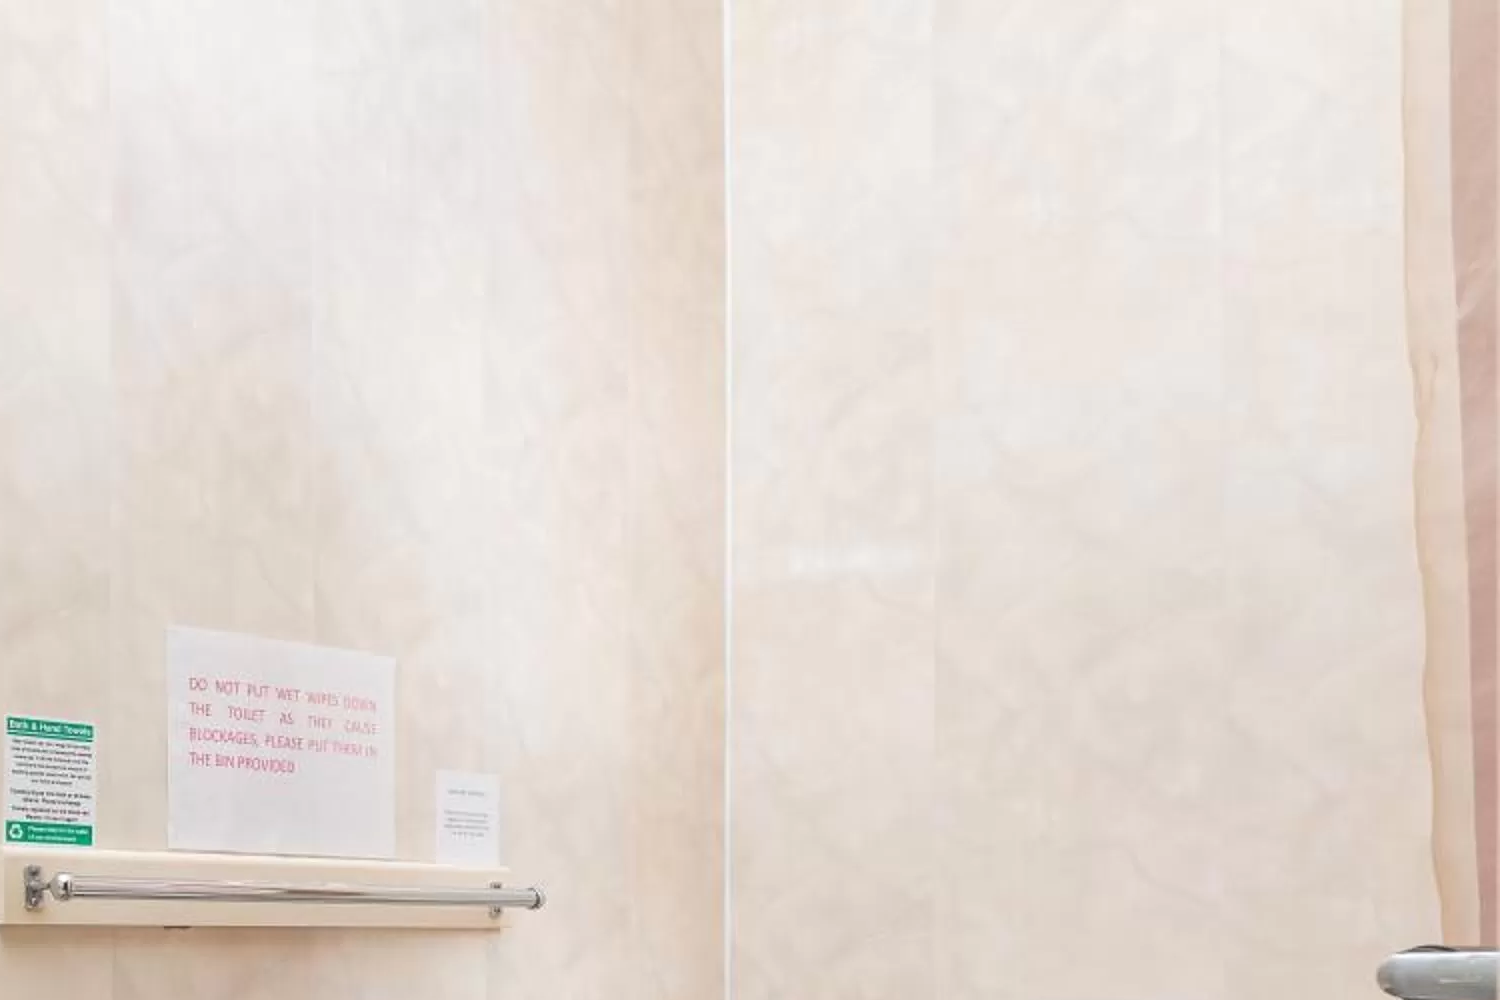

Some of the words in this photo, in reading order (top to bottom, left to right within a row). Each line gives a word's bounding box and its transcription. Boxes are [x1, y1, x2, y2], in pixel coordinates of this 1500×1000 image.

[188, 677, 209, 691] DO
[215, 679, 241, 696] NOT
[247, 683, 270, 698] PUT
[275, 687, 301, 702] WET
[189, 702, 212, 717] THE
[227, 706, 266, 722] TOILET
[280, 711, 295, 725] AS
[264, 735, 305, 751] PLEASE
[307, 739, 328, 753] PUT
[188, 752, 212, 768] THE
[215, 753, 235, 769] BIN
[237, 755, 296, 774] PROVIDED
